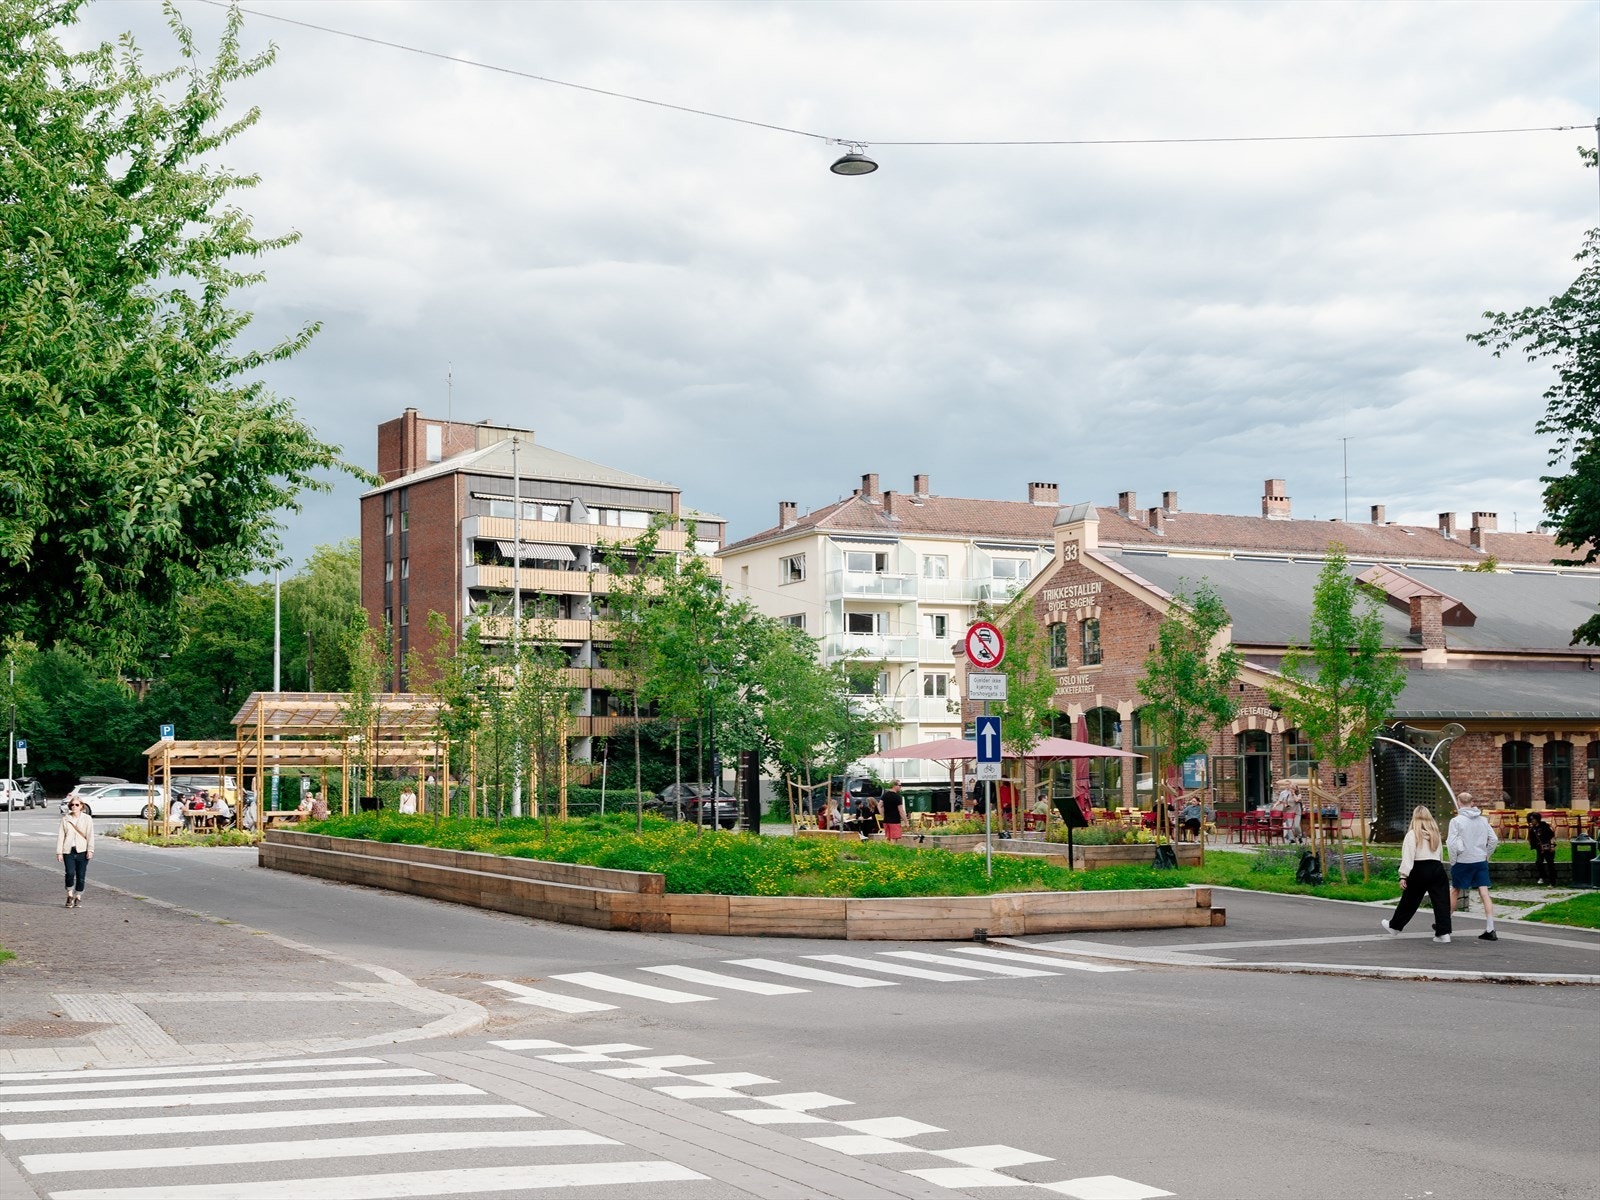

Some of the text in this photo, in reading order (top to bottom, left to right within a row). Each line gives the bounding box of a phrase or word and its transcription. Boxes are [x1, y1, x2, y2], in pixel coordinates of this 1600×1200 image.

[1065, 544, 1077, 561] 33
[1043, 581, 1101, 601] TRIKKESTALLEN
[1048, 596, 1096, 611] BYDEL SAGENE
[1060, 674, 1090, 686] OSLO NYE
[164, 726, 170, 736] P
